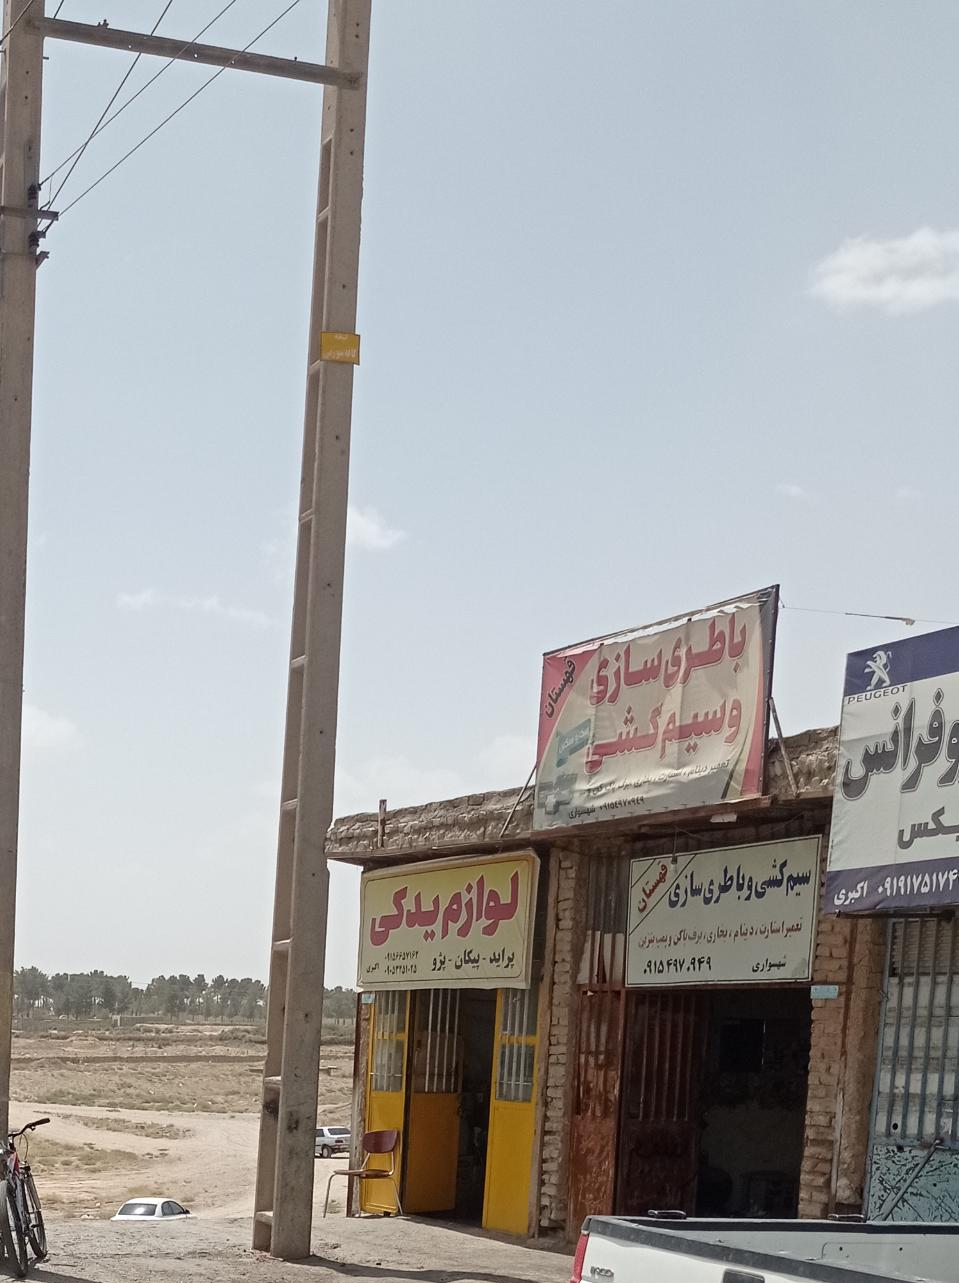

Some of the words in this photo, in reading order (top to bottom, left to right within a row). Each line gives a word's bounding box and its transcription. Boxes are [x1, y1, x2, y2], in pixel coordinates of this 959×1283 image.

[590, 643, 663, 705] سازی
[847, 684, 909, 705] PEUGEOT
[754, 858, 788, 900] کشی
[786, 868, 811, 897] سیم
[834, 880, 868, 906] اکبری
[877, 868, 959, 897] ۰۹۱۹۱۷۵۱۷۴
[369, 885, 441, 947] یدکی
[441, 869, 520, 940] لوازم
[432, 952, 446, 972] پژو
[454, 948, 480, 970] پیکان
